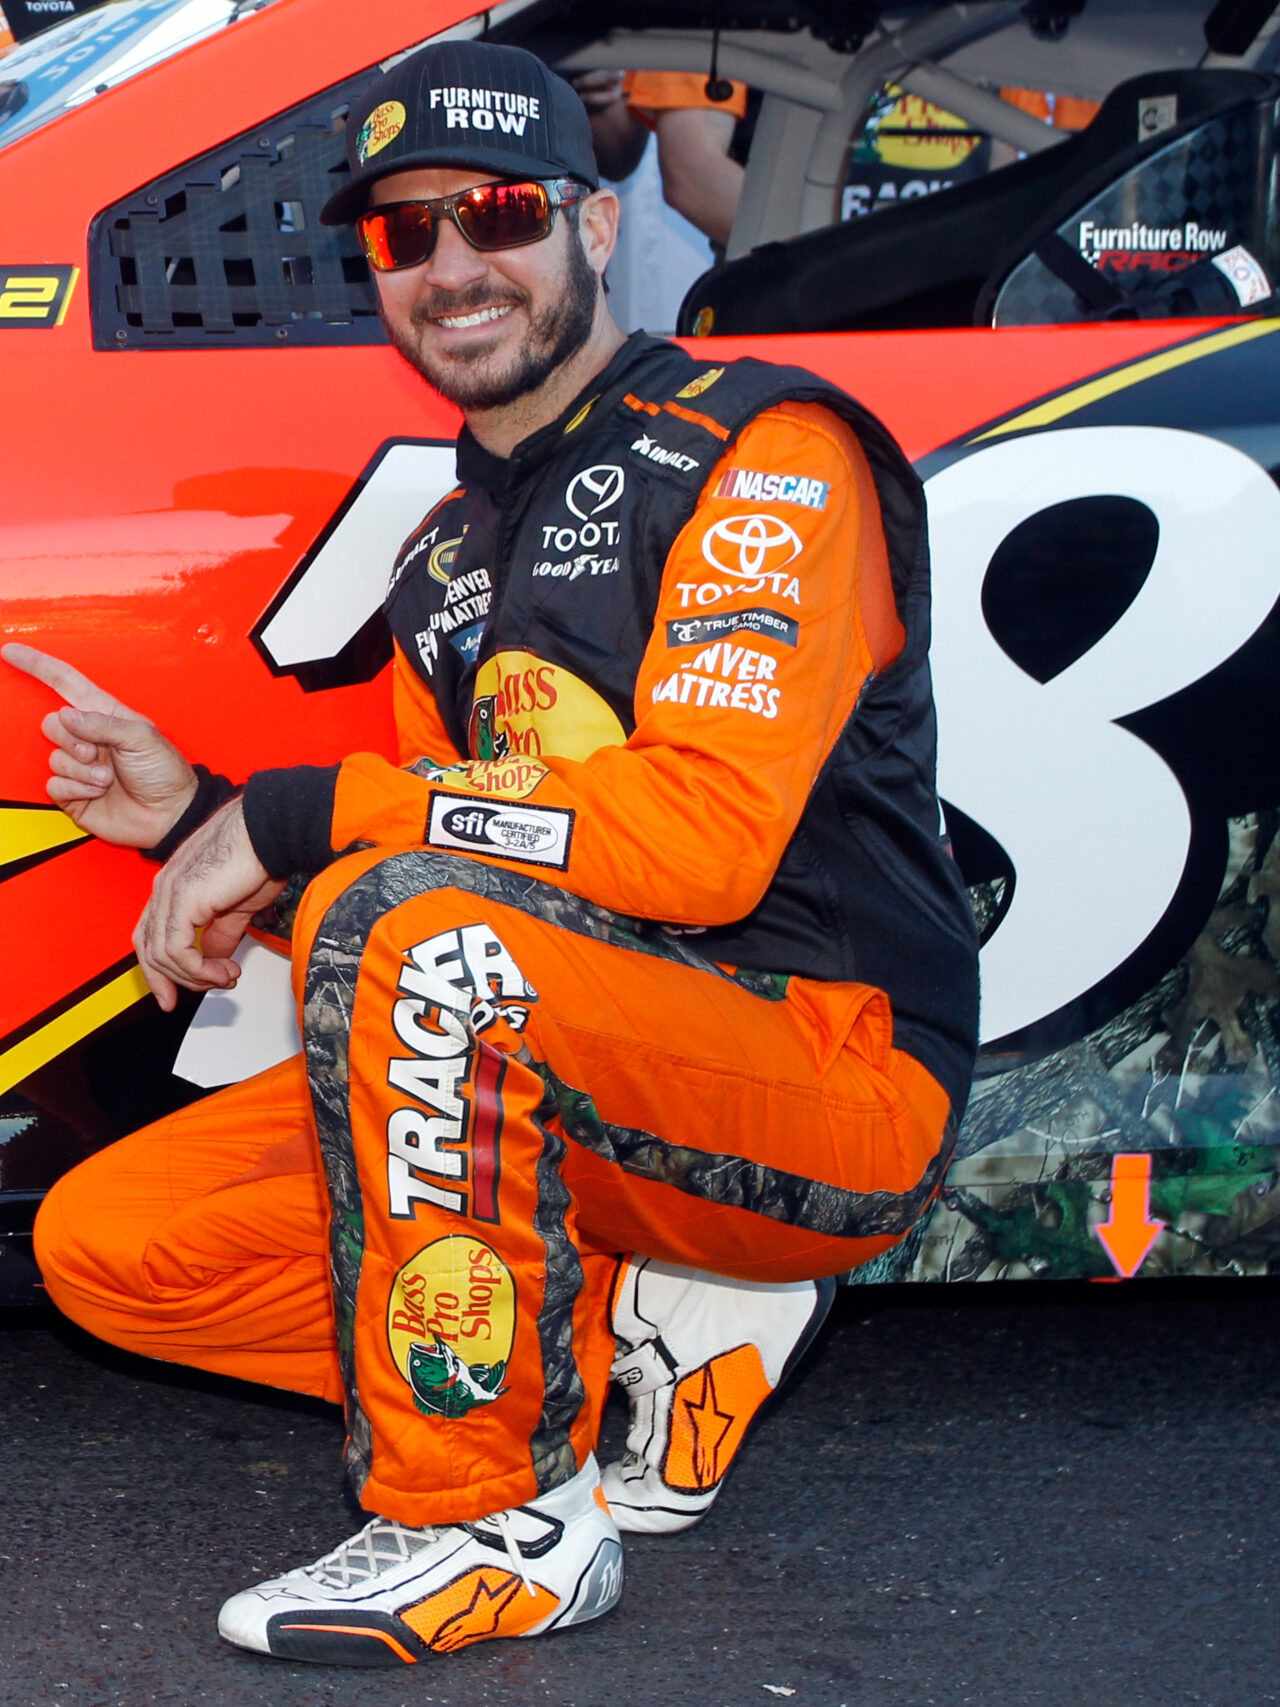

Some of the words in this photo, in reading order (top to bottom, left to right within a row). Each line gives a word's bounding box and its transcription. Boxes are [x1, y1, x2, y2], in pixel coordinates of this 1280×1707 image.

[25, 1, 76, 13] TOYOTA
[429, 87, 540, 119] FURNITURE
[446, 108, 528, 136] ROW
[1079, 220, 1182, 251] Furniture
[1184, 221, 1227, 251] Row
[732, 469, 825, 508] NASCAR
[542, 521, 621, 552] TOOT
[703, 615, 740, 632] TRUE
[740, 612, 790, 633] TIMBER
[731, 621, 761, 632] CAMO
[681, 641, 778, 681] NVER
[467, 763, 545, 792] Shops
[451, 811, 485, 836] sfi
[492, 818, 552, 836] MANUFACTURER
[501, 829, 540, 843] CERTIFIED
[504, 837, 536, 850] 3-2A/5
[387, 922, 527, 1216] TRACKER
[391, 1271, 428, 1340] Bass
[459, 1247, 502, 1341] Shops
[426, 1291, 460, 1343] Pro
